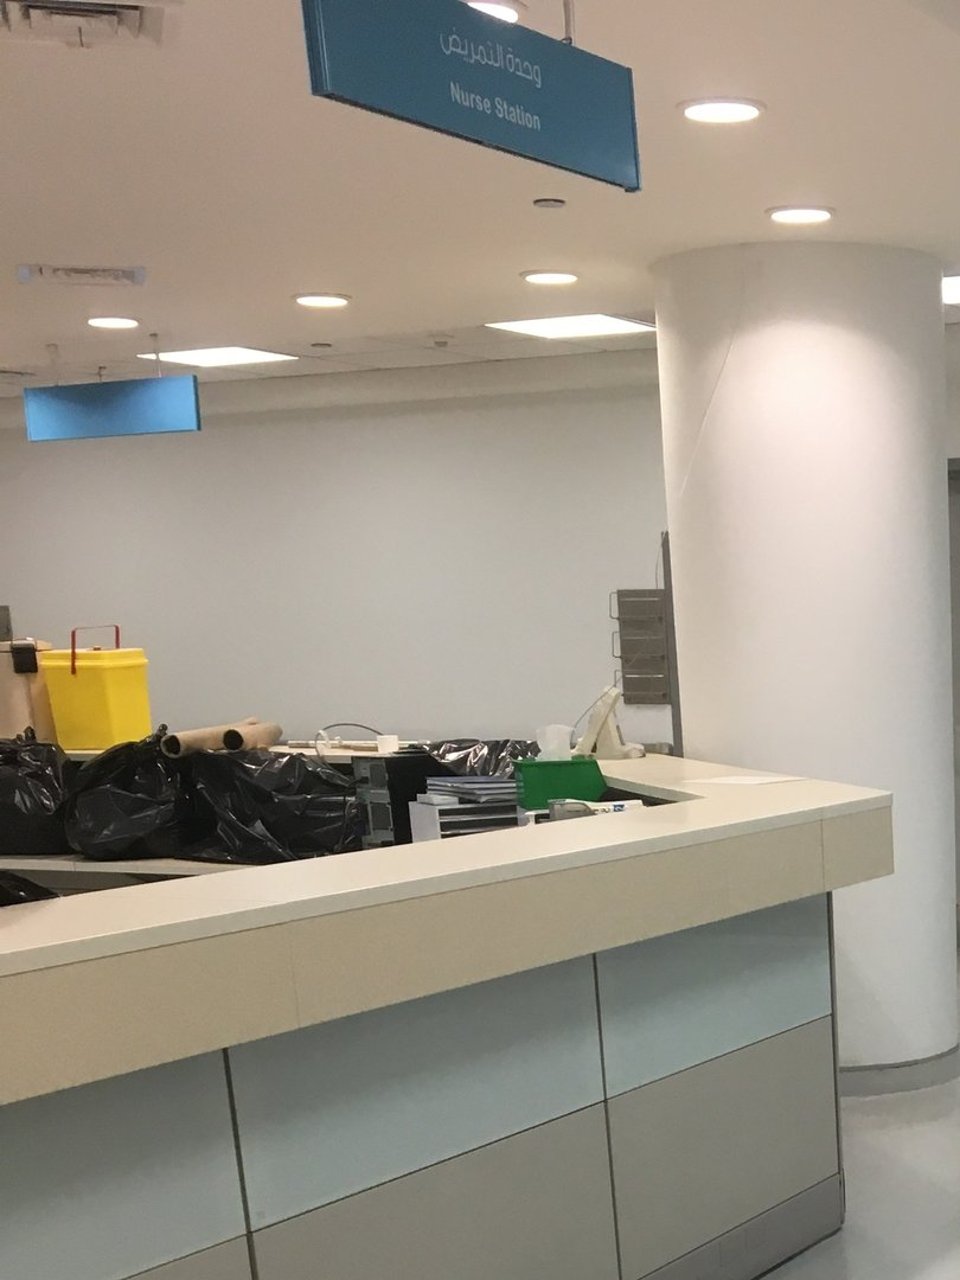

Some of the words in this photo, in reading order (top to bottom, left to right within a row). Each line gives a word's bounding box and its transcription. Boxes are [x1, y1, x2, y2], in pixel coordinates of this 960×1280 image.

[440, 26, 505, 69] التمريض
[504, 47, 542, 89] وحدة
[449, 80, 491, 114] Nurse
[494, 97, 541, 131] Station
